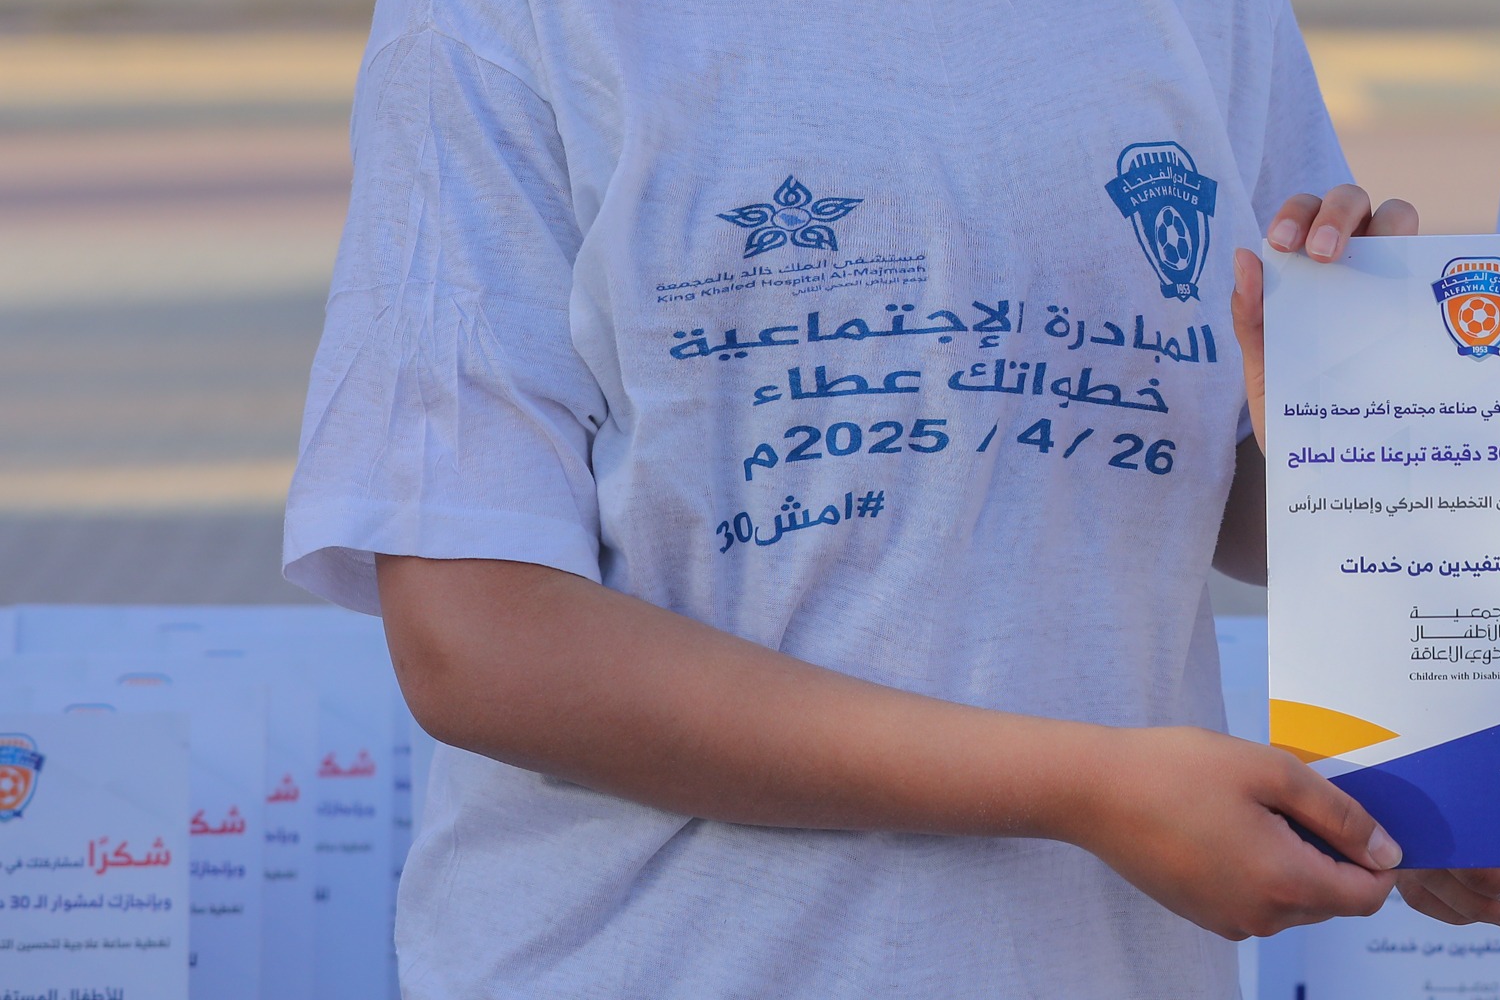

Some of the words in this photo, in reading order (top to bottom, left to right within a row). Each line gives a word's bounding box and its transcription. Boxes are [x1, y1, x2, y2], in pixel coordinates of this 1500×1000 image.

[1122, 167, 1172, 192] الفيحاء
[1130, 186, 1172, 206] ALFAYHA
[1172, 186, 1199, 205] CLUB
[742, 265, 772, 278] خالد
[779, 260, 827, 274] الملك
[656, 272, 734, 292] بالمجمعة
[657, 291, 696, 304] King
[701, 281, 756, 297] Khaled
[761, 272, 825, 289] Hospital
[830, 265, 926, 281] Al-Majmaah
[1442, 272, 1488, 289] الفيحاء
[1444, 284, 1486, 298] ALFAYHA
[669, 300, 1025, 362] الإجتماعية
[1044, 304, 1218, 363] المبادرة
[1472, 346, 1488, 354] 1953
[753, 364, 922, 406] عطاء
[948, 360, 1169, 414] خطواتك
[1284, 403, 1327, 419] ونشاط
[1331, 404, 1360, 415] صحة
[1364, 400, 1389, 418] أكثر
[1394, 404, 1435, 418] مجتمع
[1440, 402, 1477, 414] صناعة
[1481, 401, 1500, 421] في
[1016, 418, 1055, 455] 4
[743, 418, 949, 480] 2025م
[1108, 433, 1177, 476] 26
[1288, 447, 1334, 468] لصالح
[1341, 447, 1375, 462] عنك
[1382, 446, 1427, 466] تبرعنا
[1431, 444, 1481, 466] دقيقة
[1289, 495, 1326, 513] الرأس
[1331, 498, 1382, 513] وإصابات
[1386, 497, 1433, 515] الحركي
[1438, 496, 1492, 512] التخطيط
[1341, 556, 1402, 573] خدمات
[1408, 561, 1433, 576] من
[1409, 672, 1448, 681] Children
[1450, 672, 1470, 681] with
